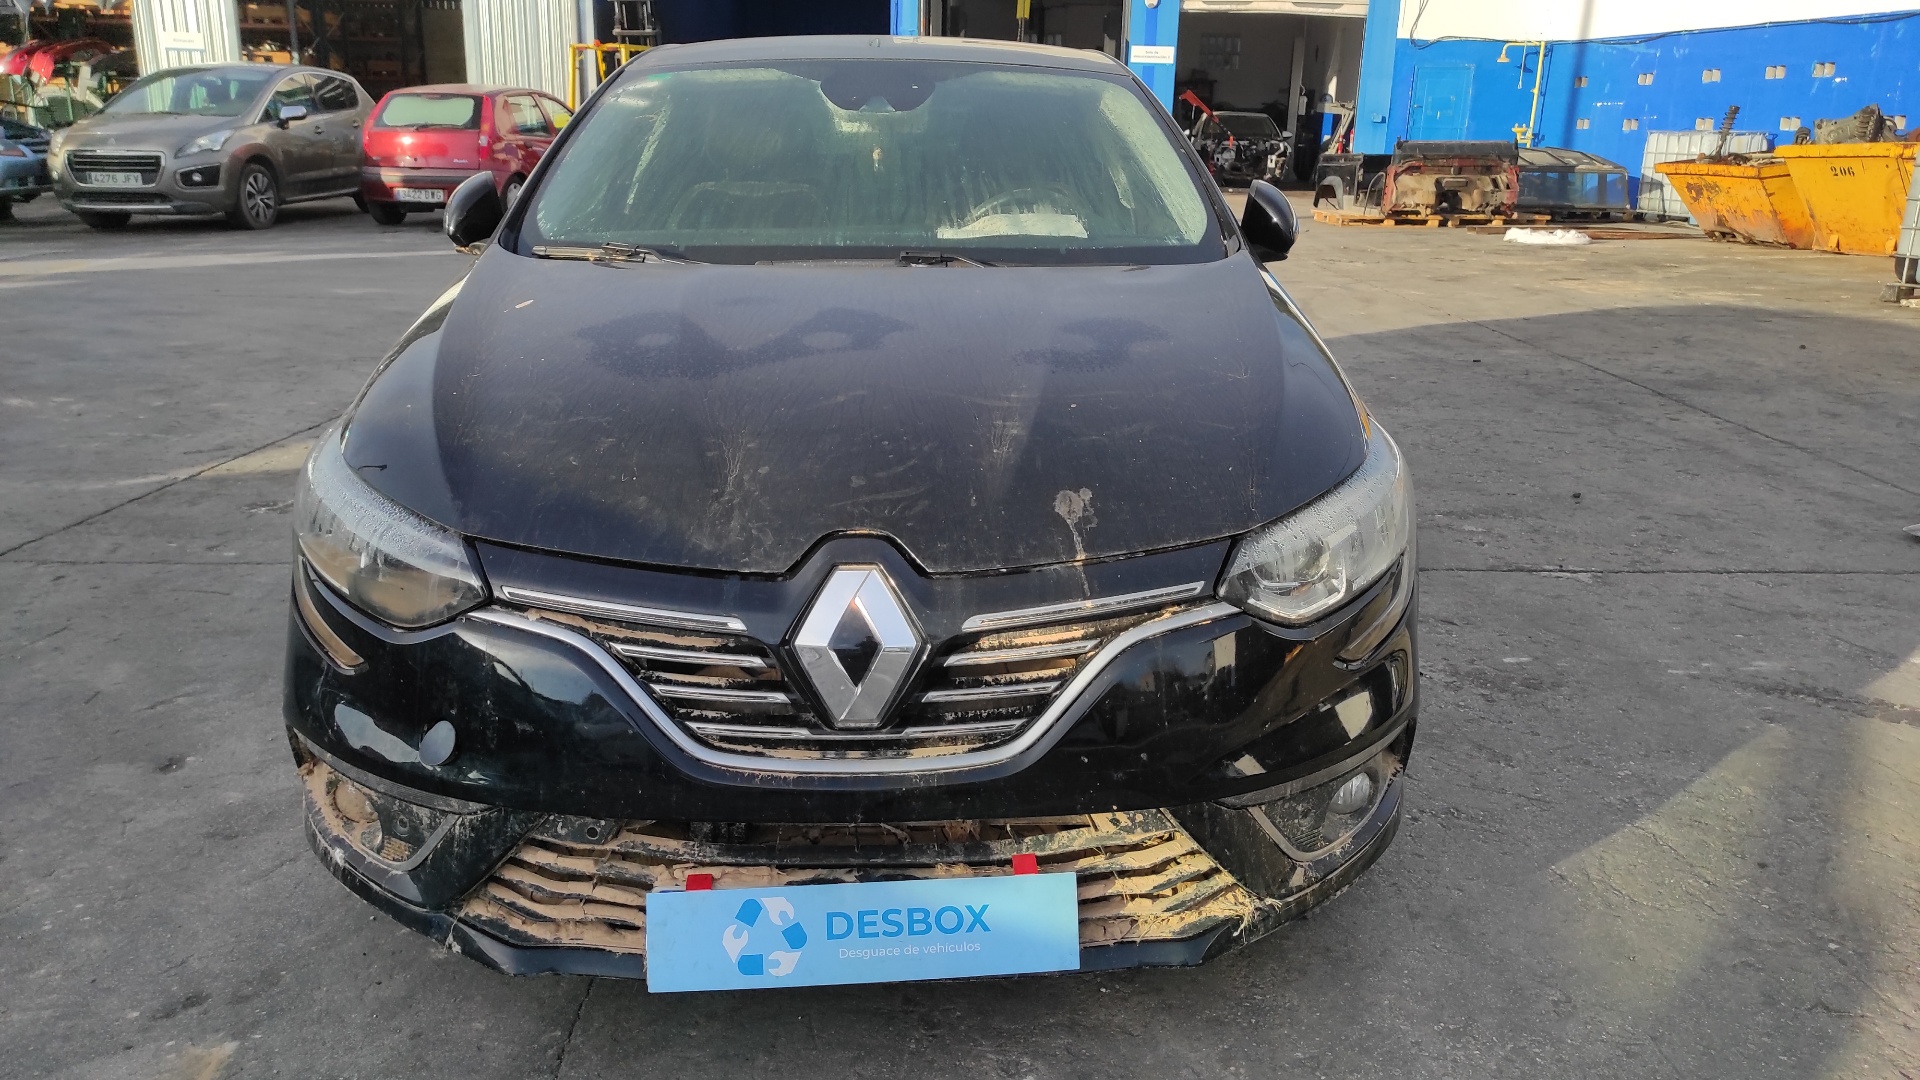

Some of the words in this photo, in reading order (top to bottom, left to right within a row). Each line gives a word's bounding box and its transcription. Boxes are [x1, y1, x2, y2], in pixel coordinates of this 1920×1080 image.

[1830, 166, 1855, 176] 206
[94, 174, 118, 183] 4276
[122, 174, 139, 183] JFV
[826, 904, 991, 940] DESBOX
[839, 948, 900, 959] Desguace
[904, 945, 919, 954] de
[922, 942, 981, 954] vehículos
